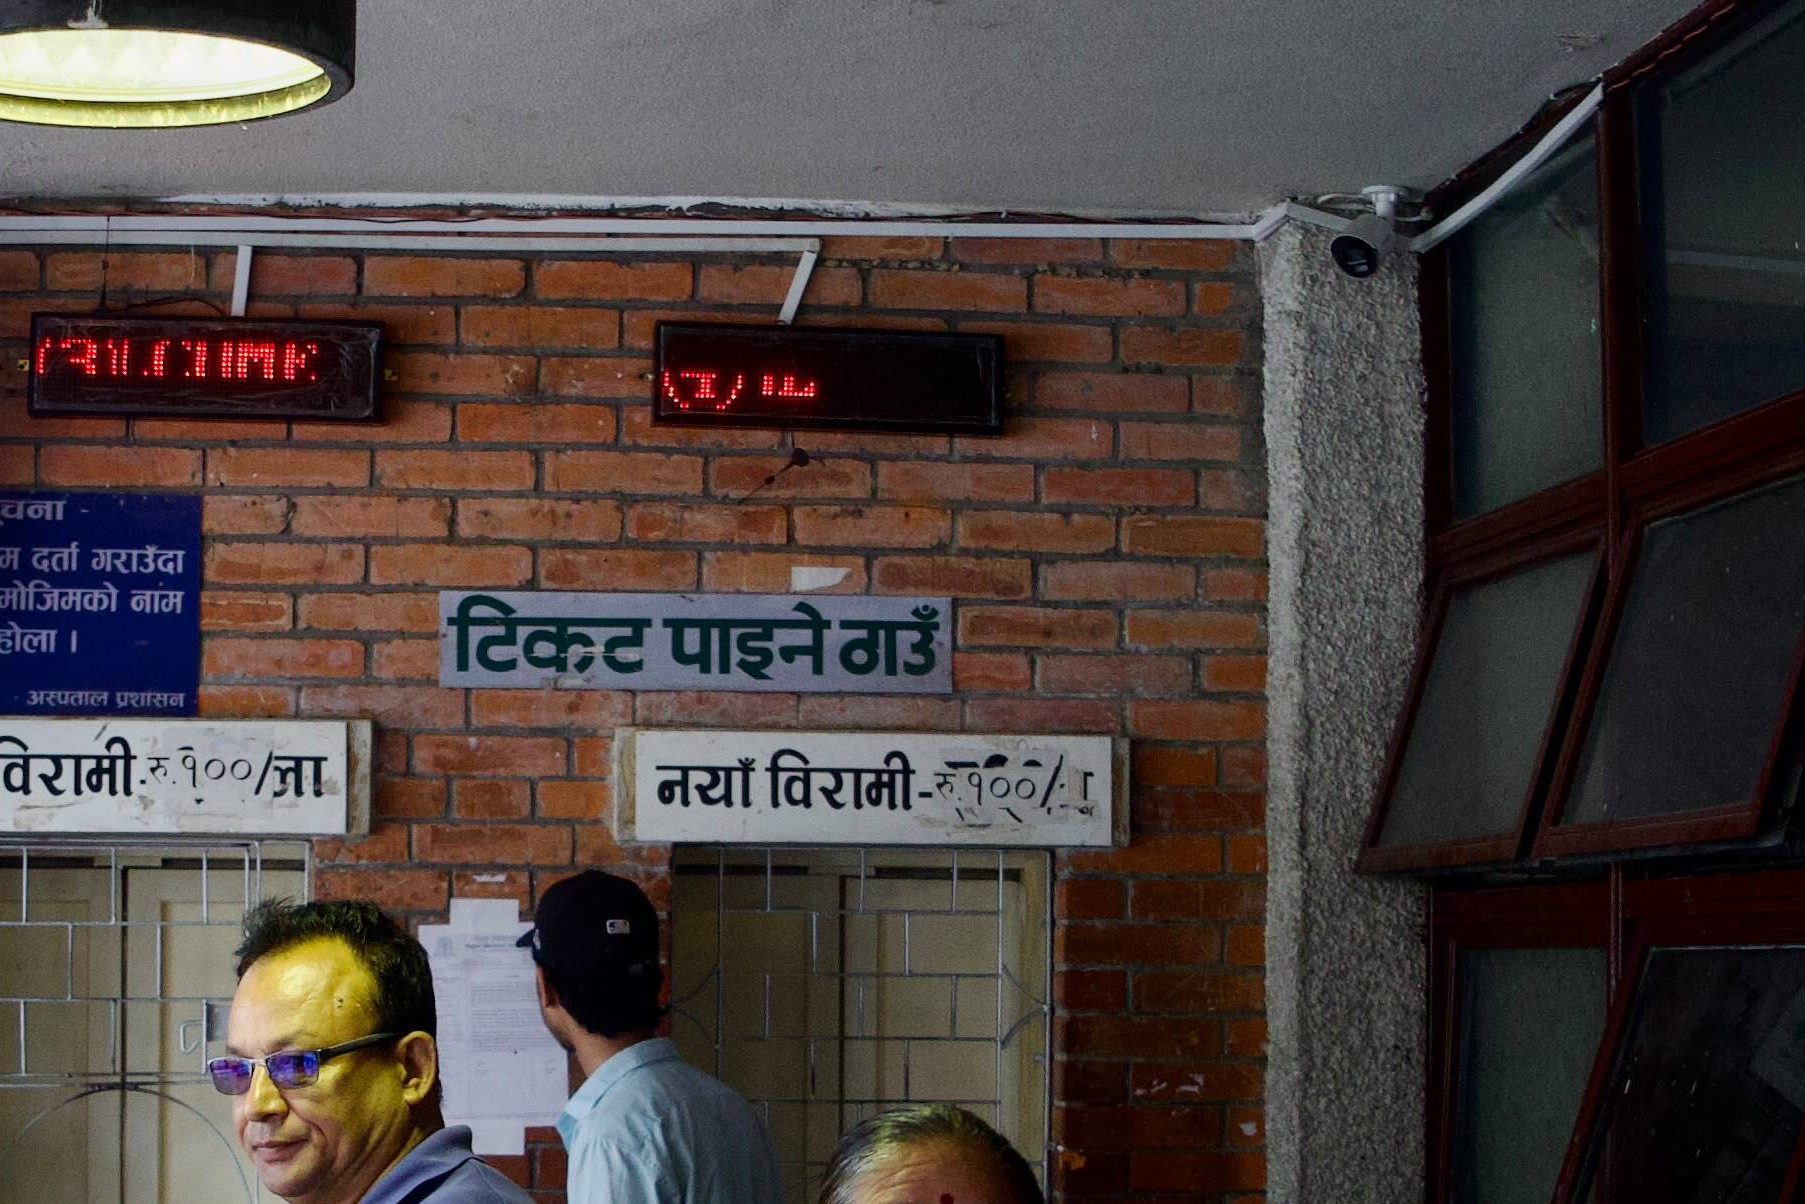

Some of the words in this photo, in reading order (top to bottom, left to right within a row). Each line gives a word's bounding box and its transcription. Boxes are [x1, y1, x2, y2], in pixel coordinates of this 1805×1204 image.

[31, 541, 80, 572] दर्ता
[91, 544, 185, 574] गराउँदा
[446, 594, 653, 675] टिकट
[661, 601, 831, 680] पाइने
[839, 604, 940, 676] ठाउँ
[27, 689, 109, 708] अस्पताल
[655, 756, 756, 810] नयाँ
